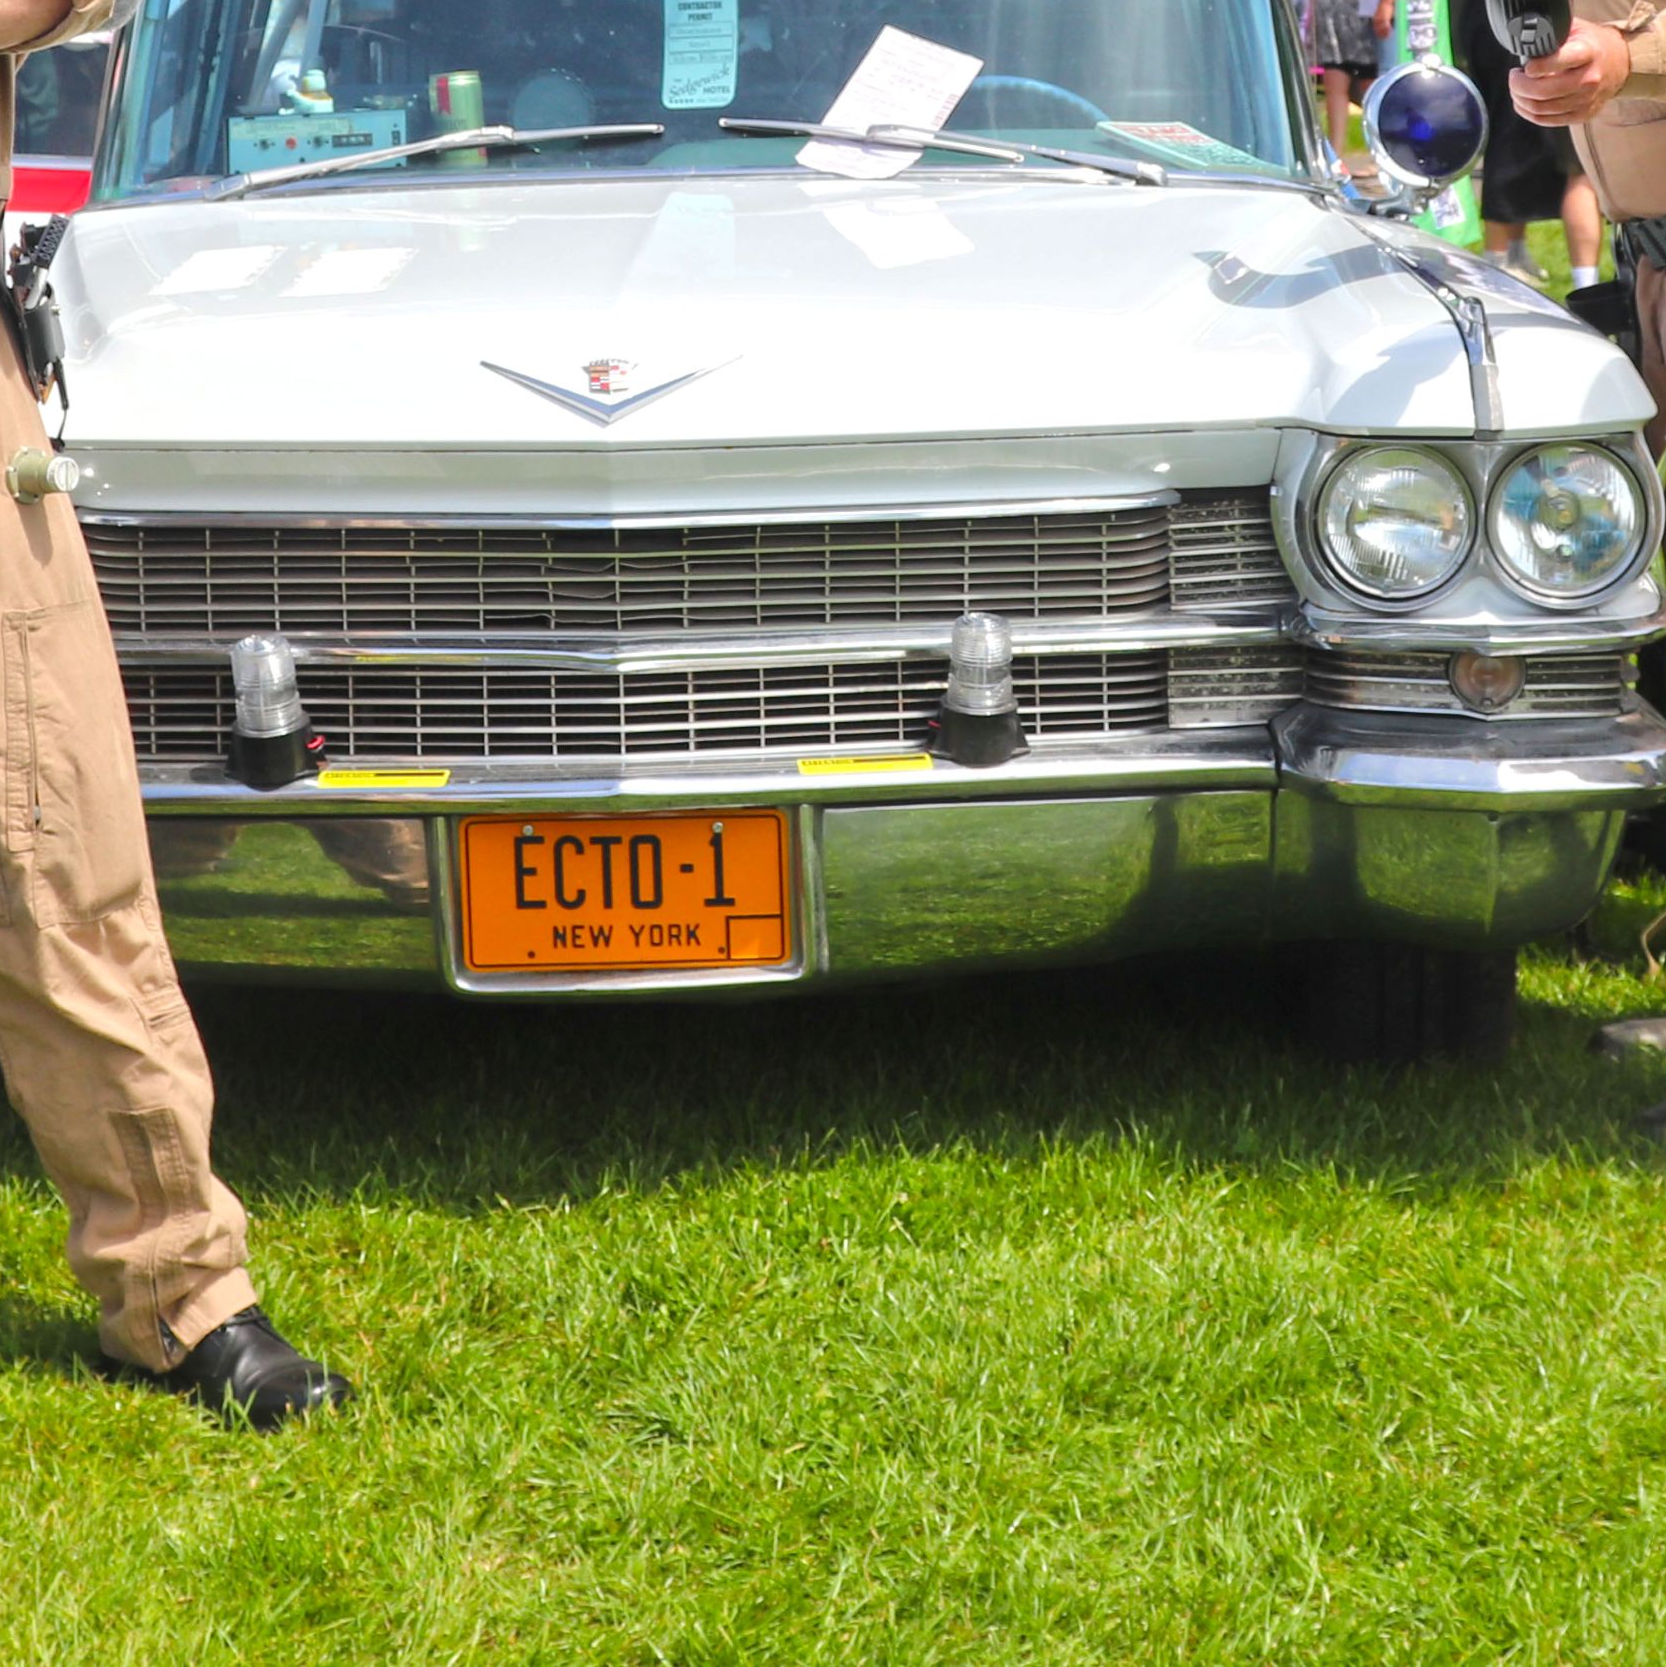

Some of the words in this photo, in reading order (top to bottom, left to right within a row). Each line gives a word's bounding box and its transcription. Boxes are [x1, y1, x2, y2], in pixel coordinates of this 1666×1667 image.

[513, 832, 736, 910] ECTO-1
[552, 924, 614, 949] NEW
[629, 922, 701, 947] YORK
